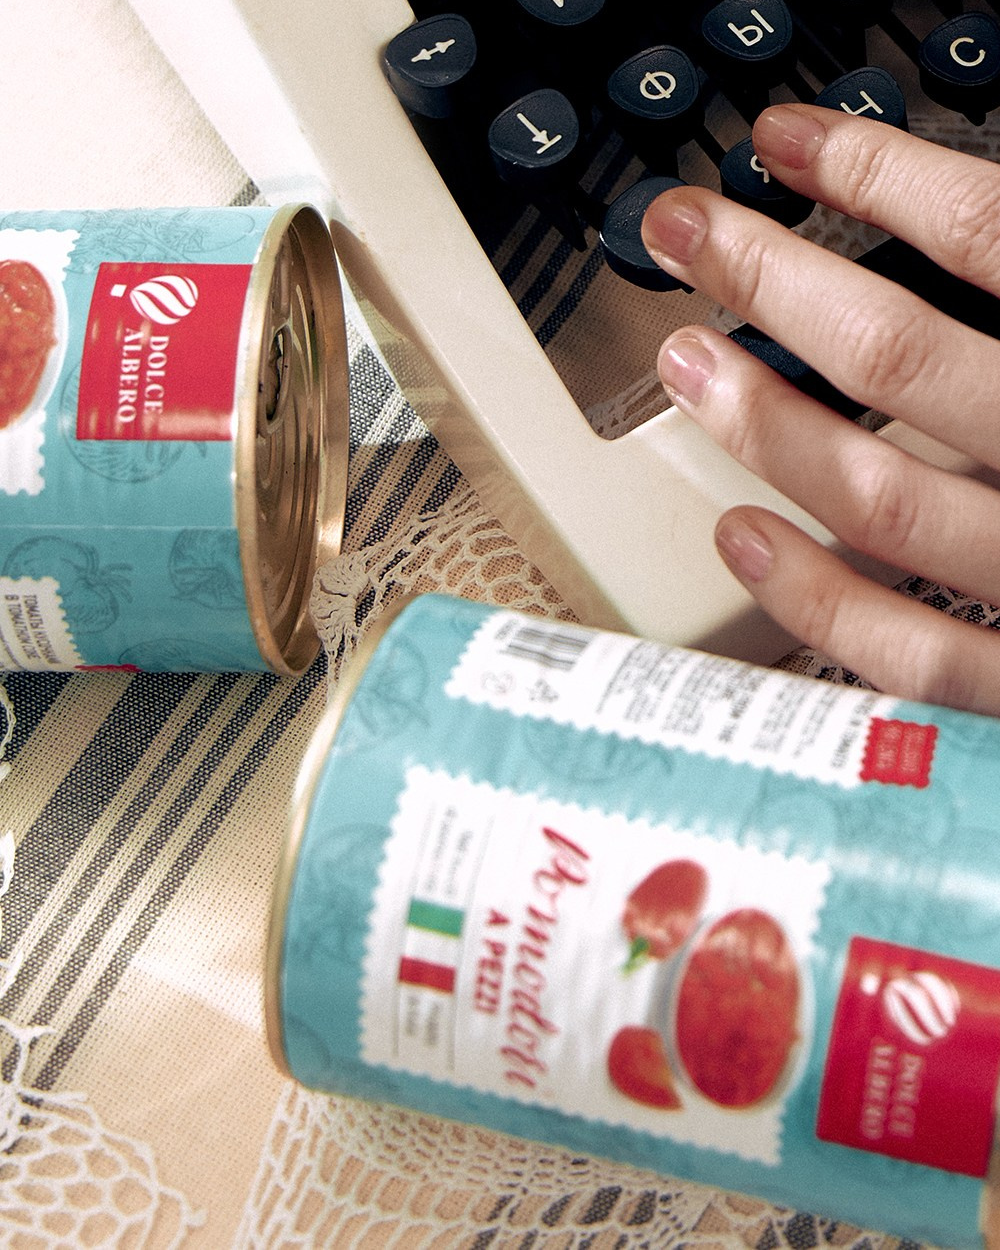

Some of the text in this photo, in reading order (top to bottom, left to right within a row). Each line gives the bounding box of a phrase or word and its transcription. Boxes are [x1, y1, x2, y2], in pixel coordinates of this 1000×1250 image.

[727, 9, 775, 48] Ы
[949, 36, 986, 67] С
[639, 70, 677, 100] Ф
[117, 327, 144, 423] ALBERO
[144, 335, 169, 415] DOLCE
[472, 937, 507, 1016] PEZZI
